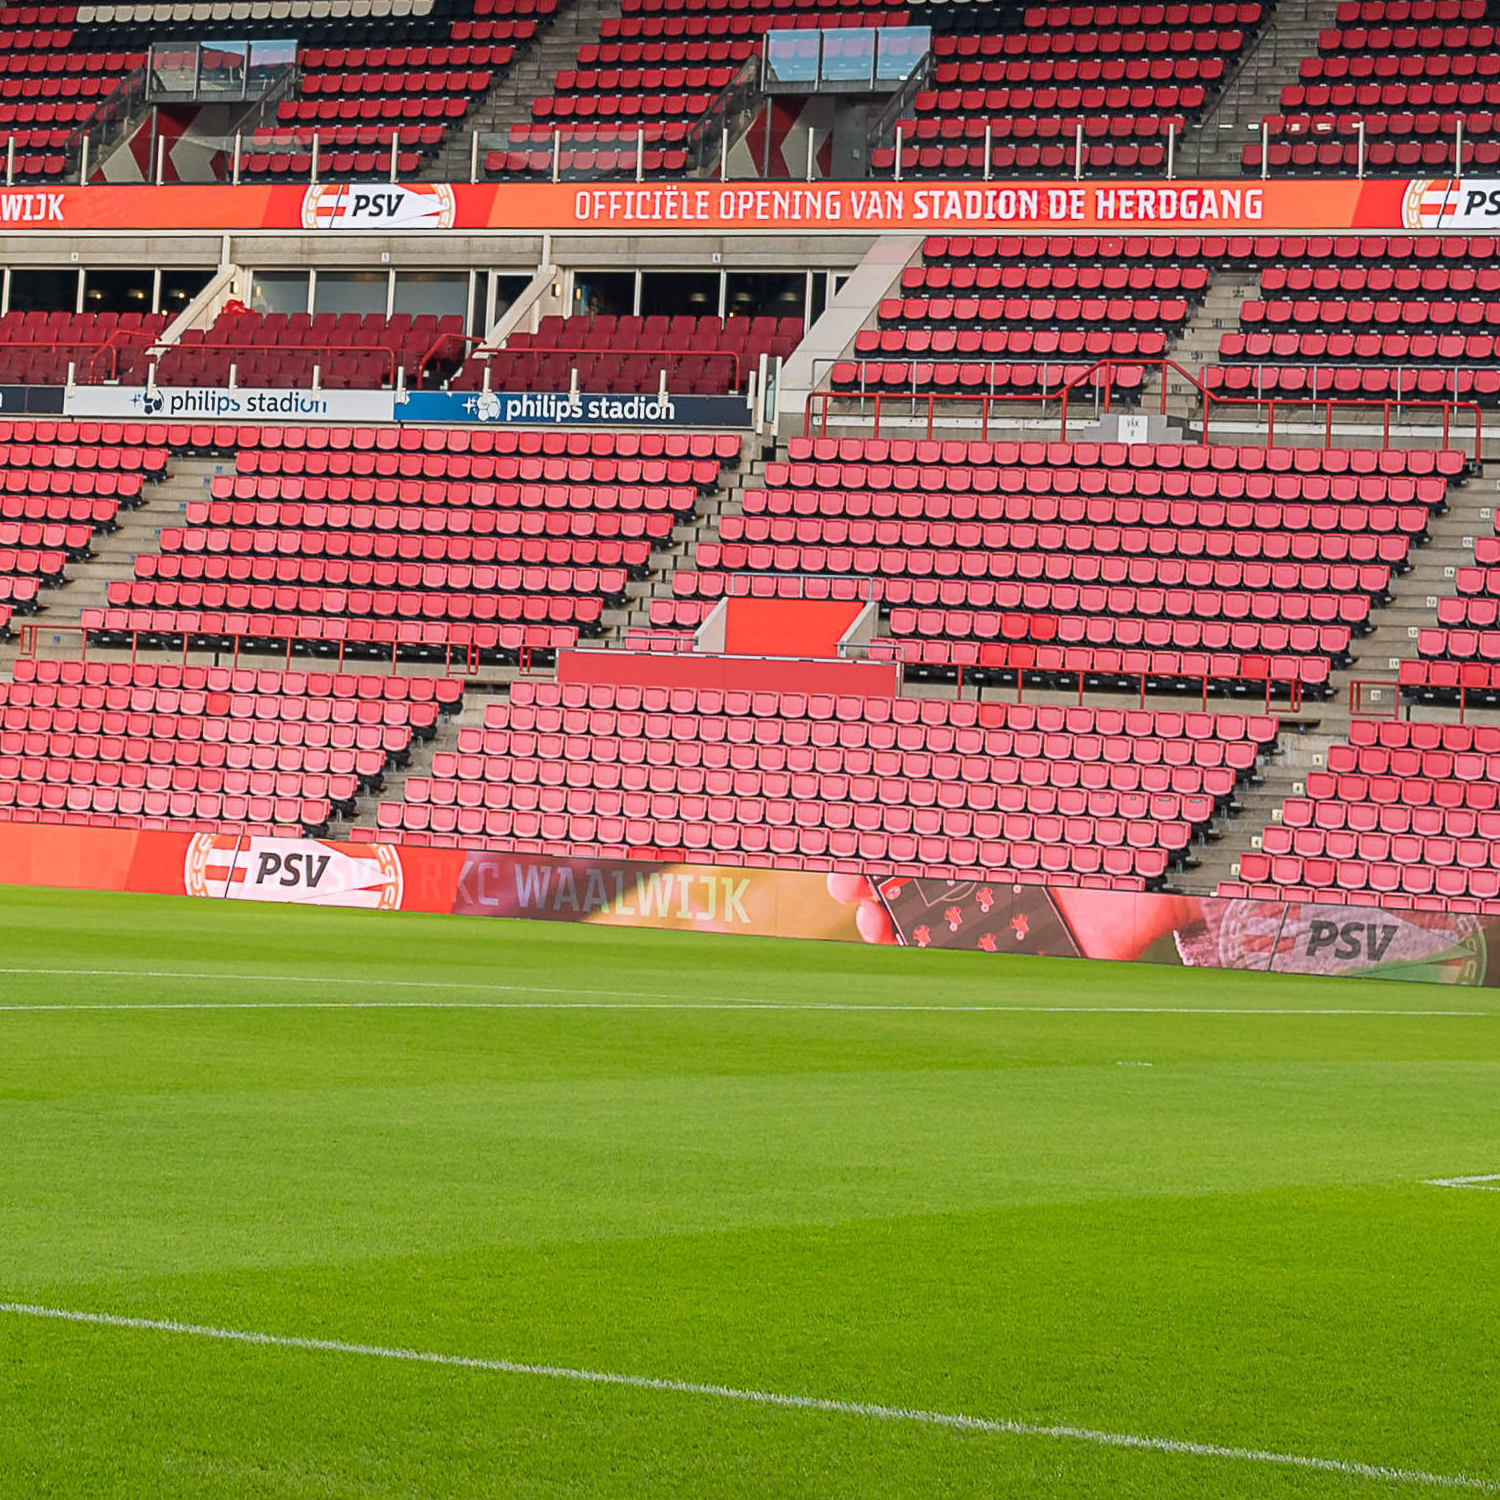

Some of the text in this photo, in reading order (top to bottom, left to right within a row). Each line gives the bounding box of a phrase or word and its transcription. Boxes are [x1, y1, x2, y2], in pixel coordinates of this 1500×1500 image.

[352, 194, 404, 218] PSV
[574, 185, 709, 220] OFFICIËLE
[719, 190, 842, 220] OPENING
[849, 190, 904, 219] VAN
[912, 189, 1038, 219] STADION
[1048, 189, 1086, 219] DE
[1094, 188, 1263, 219] HERDGANG
[170, 389, 327, 416] philips stadion
[505, 393, 675, 421] philips stadion
[256, 851, 330, 887] PSV
[514, 863, 752, 925] WAALWIJK
[1305, 919, 1398, 962] PSV
